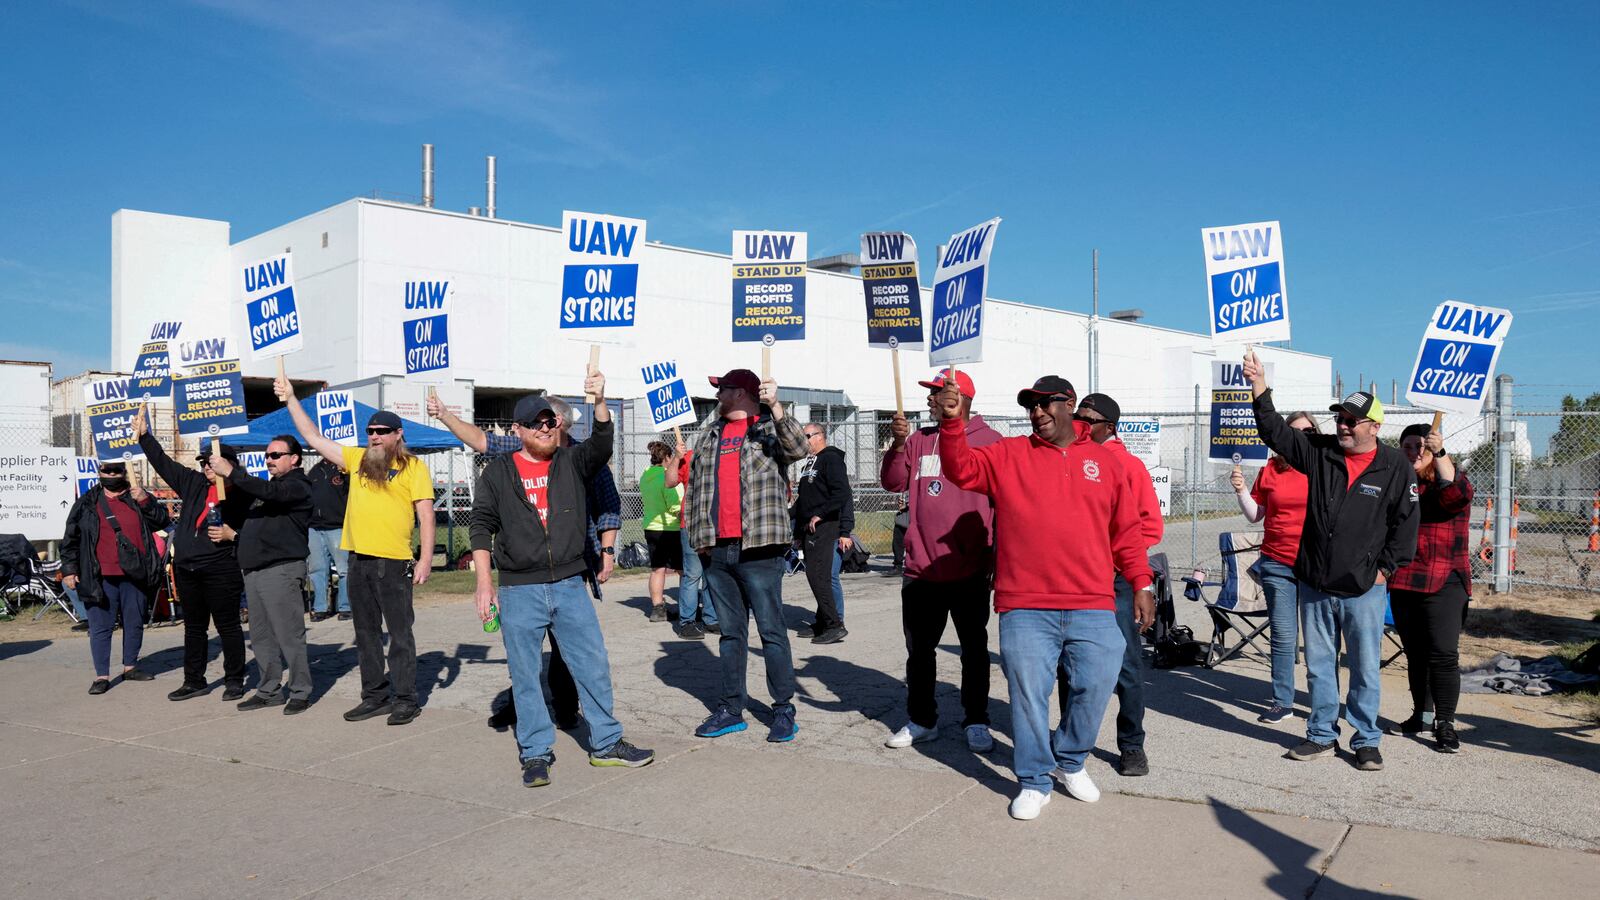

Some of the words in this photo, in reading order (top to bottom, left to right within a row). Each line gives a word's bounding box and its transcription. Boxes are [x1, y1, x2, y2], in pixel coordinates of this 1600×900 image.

[569, 218, 638, 258] UAW
[1209, 227, 1272, 261] UAW
[745, 234, 795, 260] UAW
[866, 234, 905, 260] UAW
[942, 224, 993, 269] UAW
[244, 258, 286, 292] UAW
[736, 267, 780, 277] STAND
[784, 266, 802, 275] UP
[864, 267, 896, 279] STAND
[898, 266, 913, 276] UP
[584, 268, 612, 294] ON
[745, 284, 793, 294] RECORD
[1230, 268, 1257, 298] ON
[404, 281, 449, 309] UAW
[872, 284, 909, 295] RECORD
[946, 275, 967, 310] ON
[745, 294, 793, 304] PROFITS
[873, 295, 910, 305] PROFITS
[261, 296, 279, 319] ON
[563, 296, 635, 323] STRIKE
[745, 306, 793, 316] RECORD
[874, 307, 911, 317] RECORD
[1217, 292, 1281, 329] STRIKE
[252, 311, 297, 345] STRIKE
[734, 316, 804, 327] CONTRACTS
[868, 317, 921, 328] CONTRACTS
[933, 303, 981, 347] STRIKE
[1436, 305, 1505, 339] UAW
[150, 322, 182, 340] UAW
[415, 319, 432, 343] ON
[142, 343, 168, 353] STAND
[179, 337, 226, 362] UAW
[1440, 342, 1472, 367] ON
[143, 356, 169, 366] COLA
[407, 342, 448, 371] STRIKE
[133, 369, 154, 379] FAIR
[176, 365, 217, 378] AND
[220, 363, 237, 372] UP
[641, 361, 677, 385] UAW
[1221, 364, 1253, 387] UA
[93, 379, 129, 401] UAW
[138, 378, 163, 388] NOW
[184, 379, 231, 392] RECORD
[1415, 368, 1486, 396] STRIKE
[186, 387, 232, 401] PROFITS
[320, 393, 349, 409] UAW
[658, 385, 673, 403] ON
[1215, 393, 1249, 401] STAND
[91, 403, 126, 415] STAND
[187, 398, 233, 411] RECORD
[655, 395, 689, 422] STRIKE
[1220, 408, 1255, 417] RECOR
[179, 405, 244, 421] CONTRACTS
[329, 412, 342, 426] ON
[324, 423, 354, 440] STRIKE
[1118, 422, 1158, 432] NOTICE
[1220, 428, 1259, 437] RECORD
[95, 429, 124, 442] FAIR
[40, 455, 67, 466] Park
[9, 473, 43, 483] Facility
[16, 484, 47, 493] Parking
[16, 511, 47, 519] Parking
